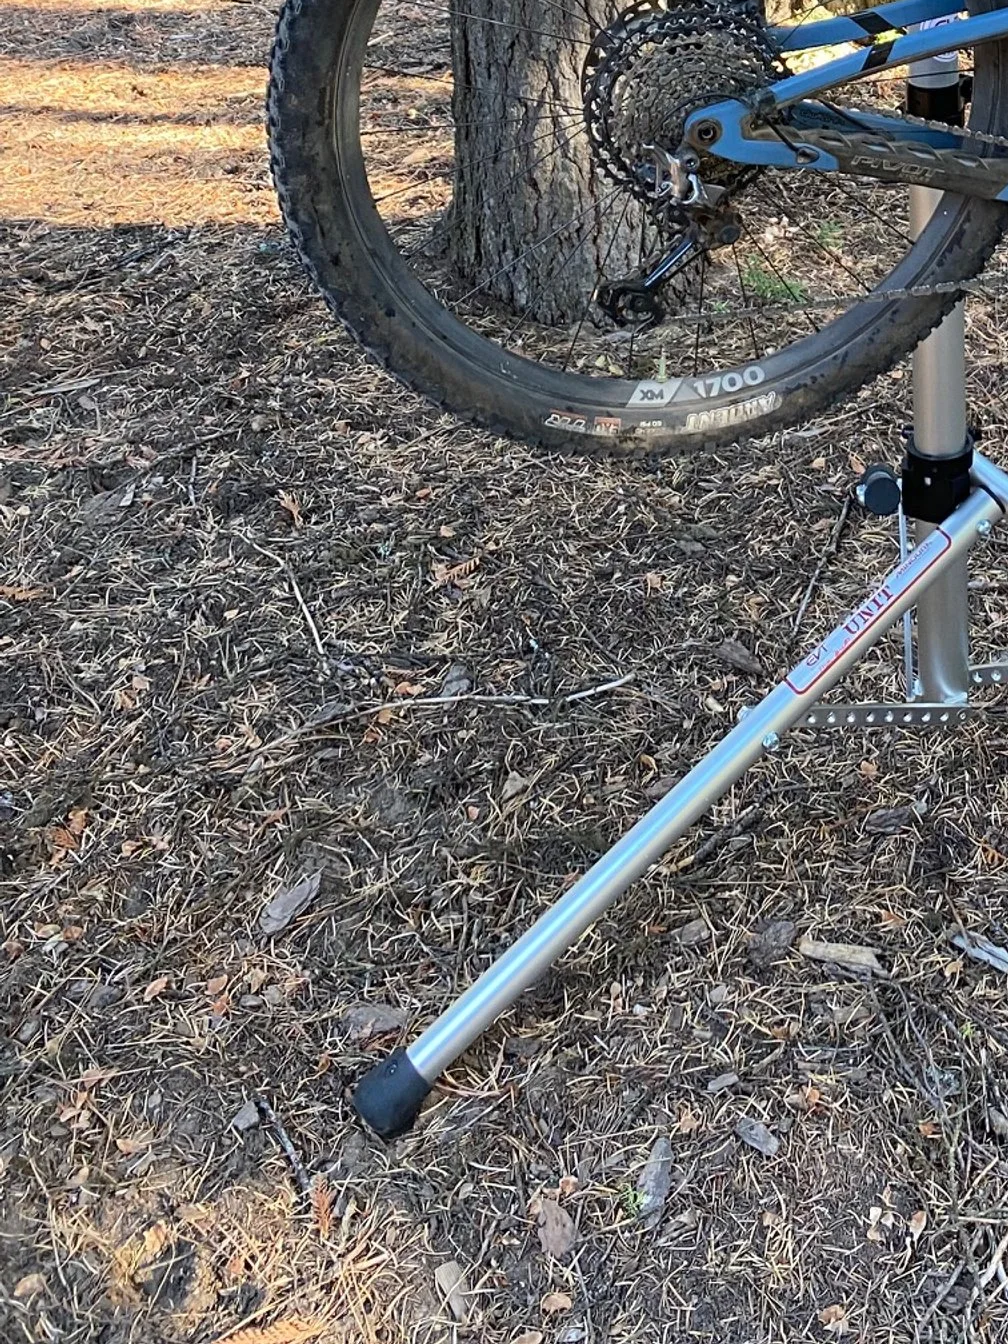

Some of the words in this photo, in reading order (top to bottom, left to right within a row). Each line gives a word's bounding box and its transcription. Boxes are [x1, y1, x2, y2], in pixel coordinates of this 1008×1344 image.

[851, 155, 945, 178] PIVOT
[639, 387, 664, 401] XM
[693, 365, 766, 399] 1700
[843, 585, 895, 635] UNIT
